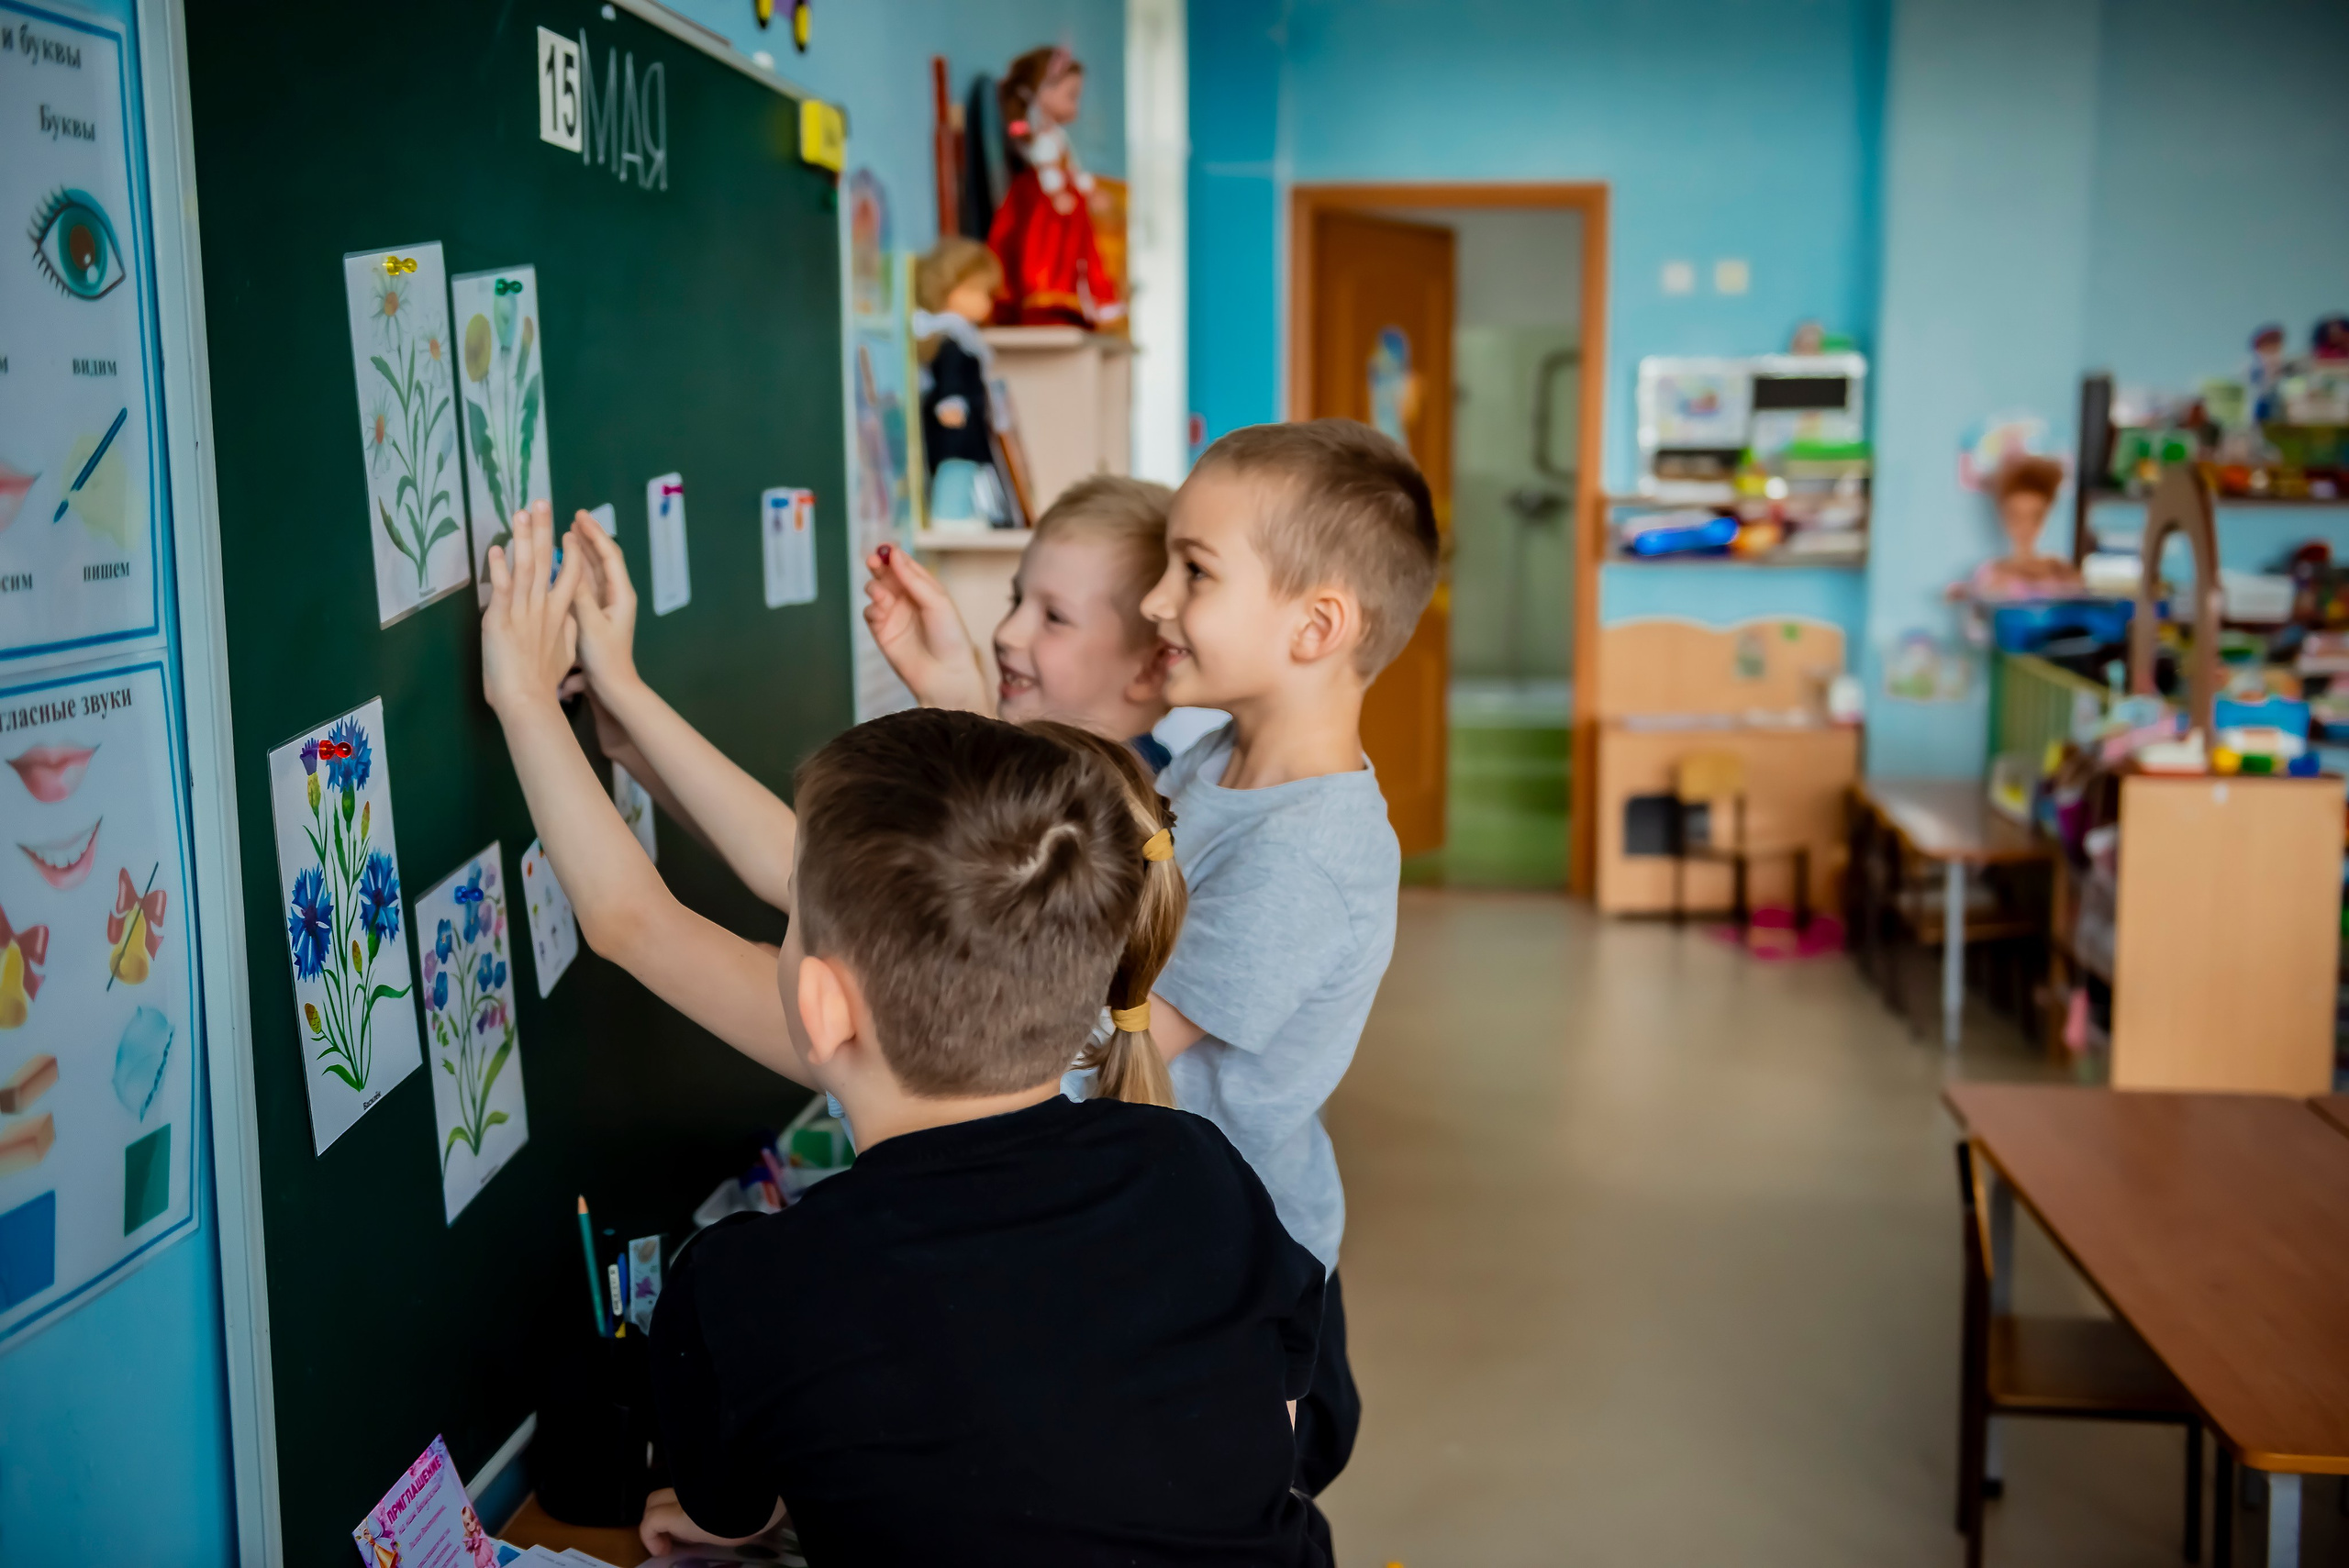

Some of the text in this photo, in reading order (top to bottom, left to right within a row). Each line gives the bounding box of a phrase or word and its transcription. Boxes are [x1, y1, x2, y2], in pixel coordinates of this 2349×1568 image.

[2, 23, 81, 70] и буквы
[546, 44, 576, 138] 15
[579, 28, 667, 191] МАЯ
[39, 104, 95, 142] Буквы
[72, 358, 117, 376] видим
[0, 572, 33, 594] сим
[83, 562, 129, 583] пишем
[81, 687, 132, 720] звуки
[386, 1454, 442, 1525] ПРИГЛАШЕНИЕ
